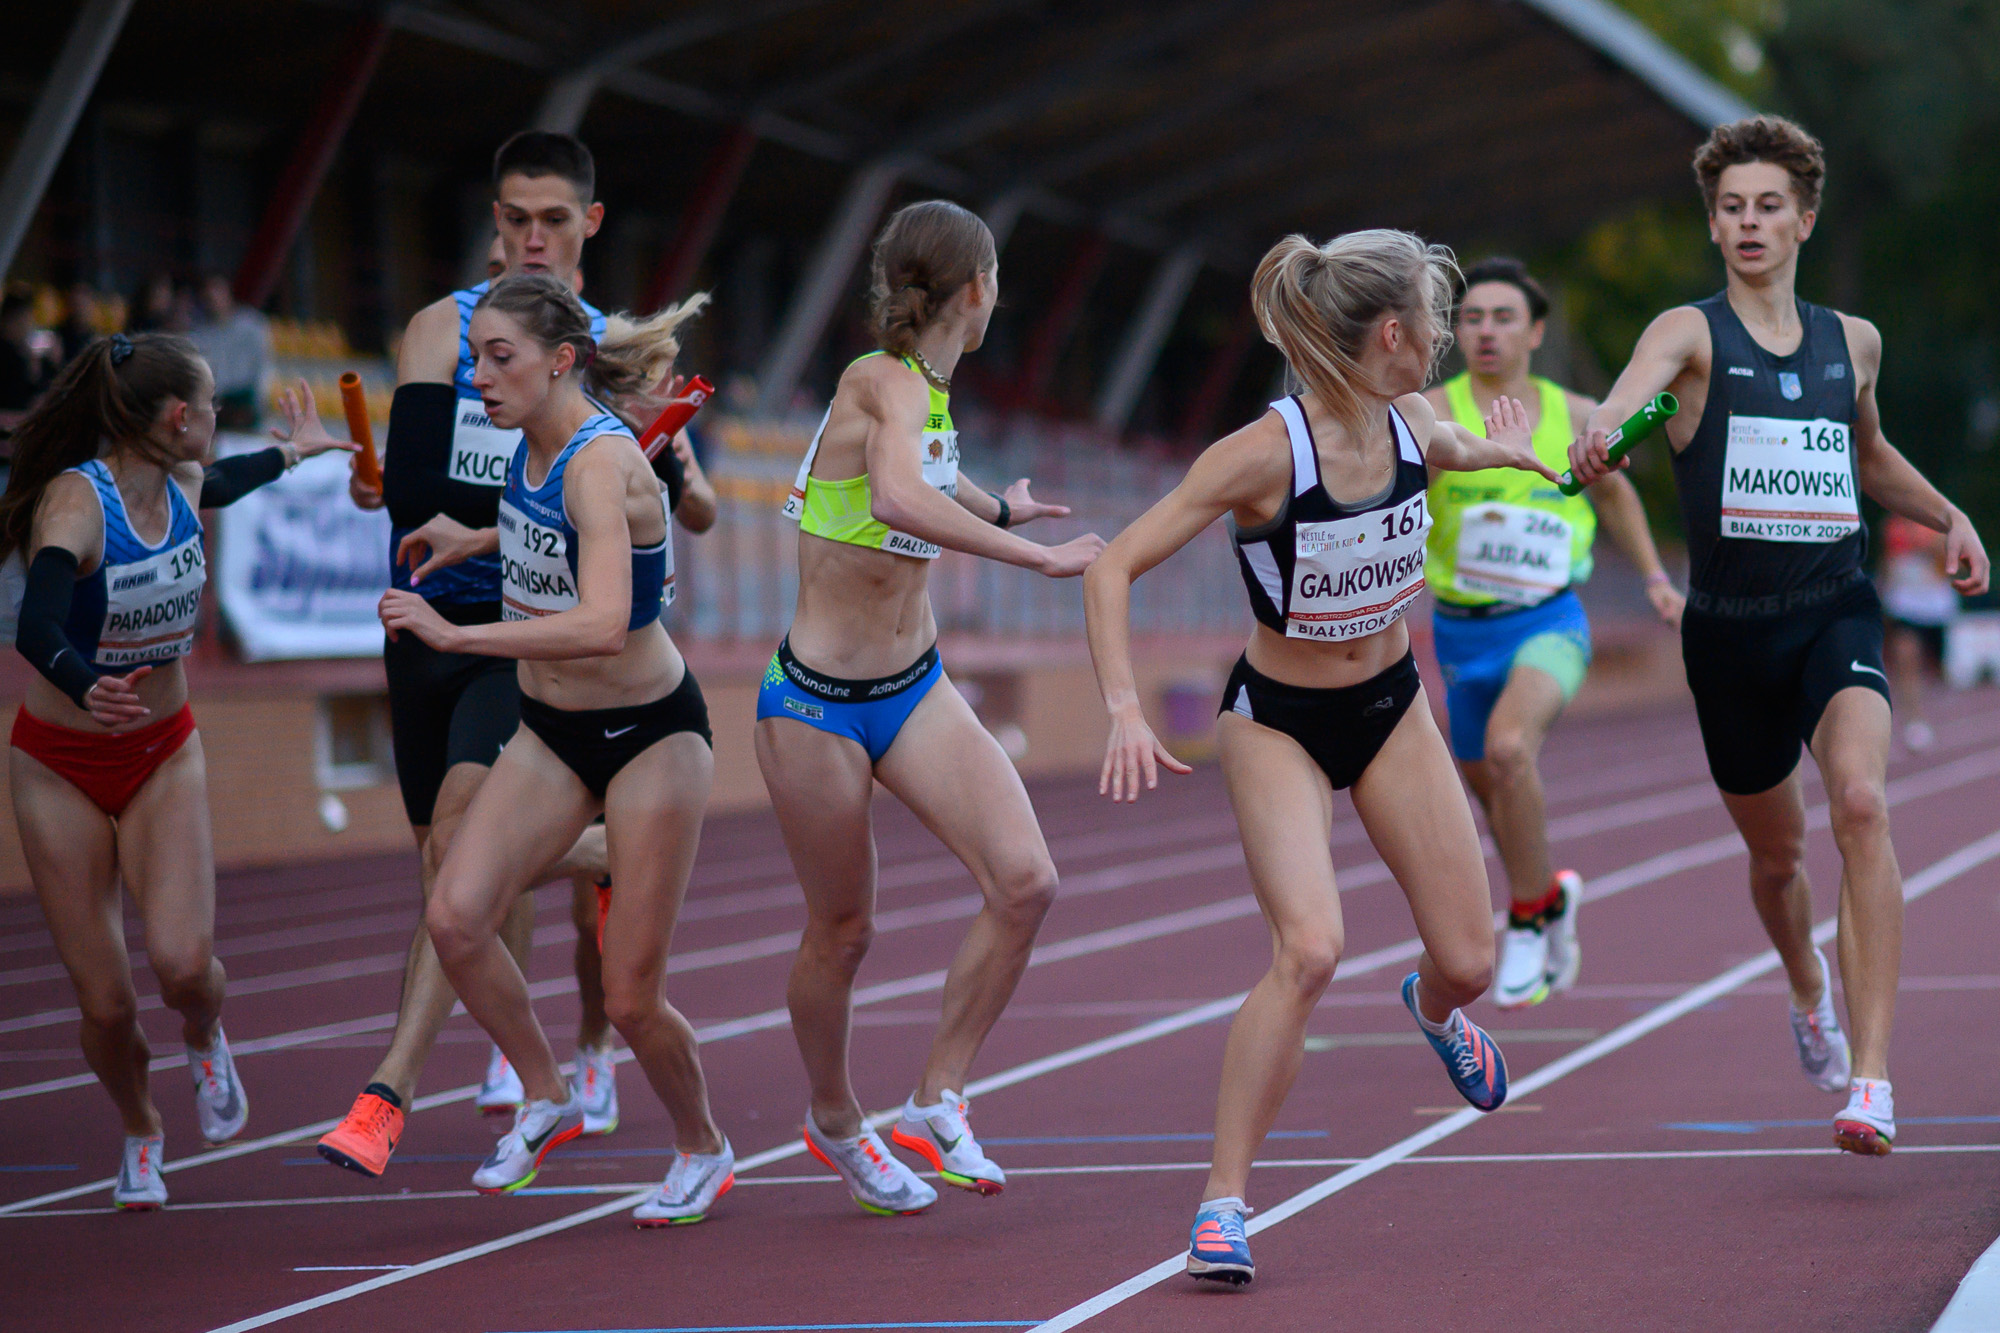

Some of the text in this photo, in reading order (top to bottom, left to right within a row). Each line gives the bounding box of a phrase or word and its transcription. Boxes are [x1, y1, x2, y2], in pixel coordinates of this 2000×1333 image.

[1800, 426, 1846, 453] 168
[1729, 467, 1852, 498] MAKOWSKI
[1380, 497, 1424, 542] 167
[1730, 521, 1813, 537] BIAŁYSTOK
[523, 522, 559, 558] 192
[170, 542, 202, 580] 190
[1476, 542, 1551, 570] JURAK
[1300, 546, 1424, 599] GAJKOWSKA
[1297, 614, 1388, 637] BIAŁYSTOK
